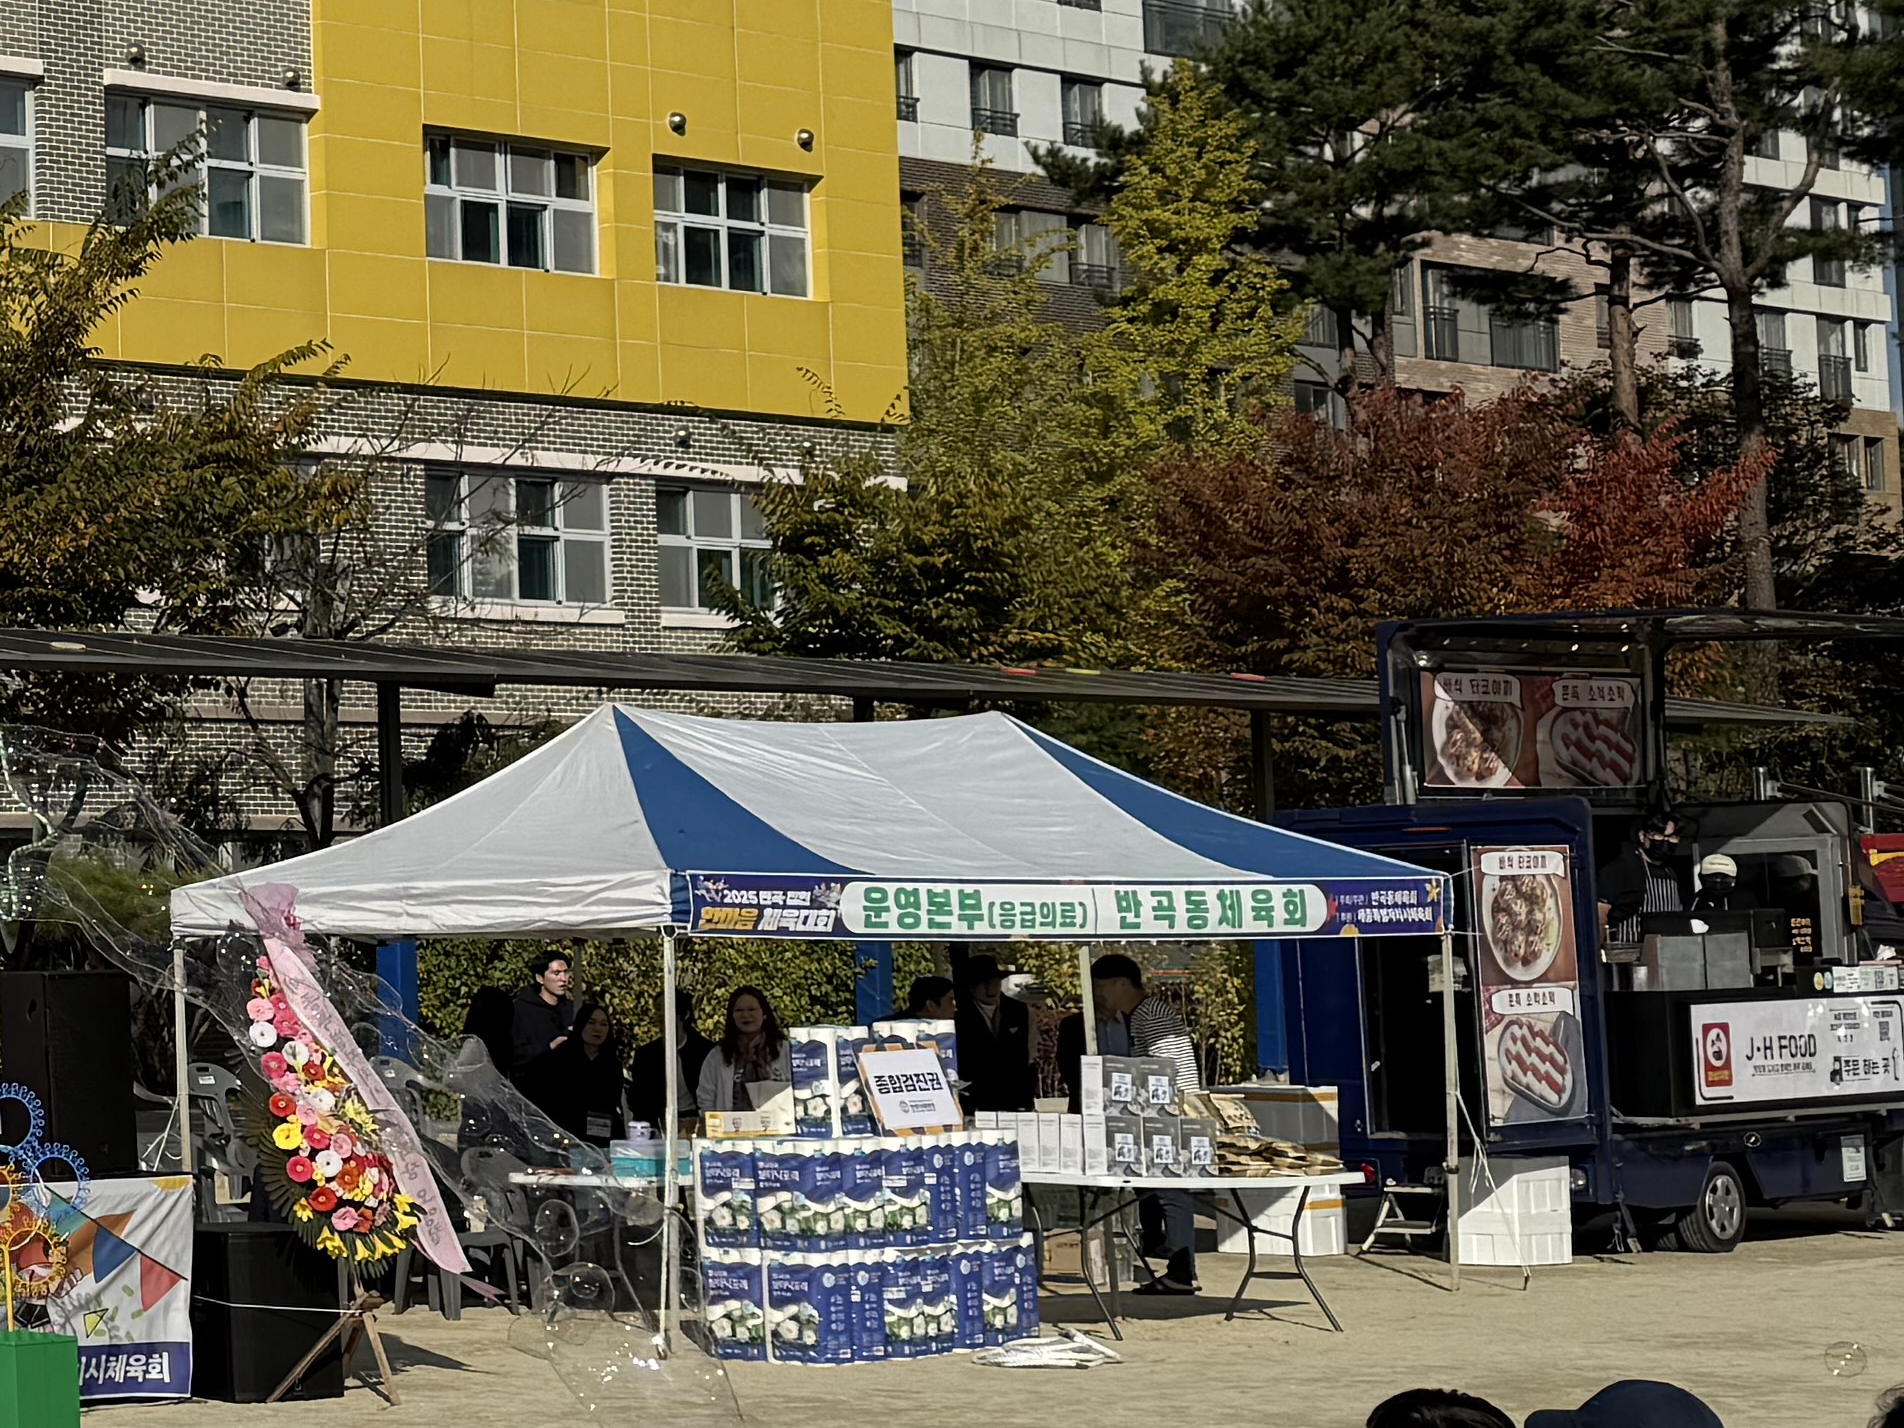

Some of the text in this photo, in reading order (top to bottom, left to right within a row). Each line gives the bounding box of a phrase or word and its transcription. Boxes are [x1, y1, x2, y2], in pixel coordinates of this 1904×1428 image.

[723, 889, 758, 905] 2025
[758, 909, 837, 932] 체육대회
[1778, 1033, 1817, 1060] FOOD
[874, 1071, 944, 1095] 종합검진권
